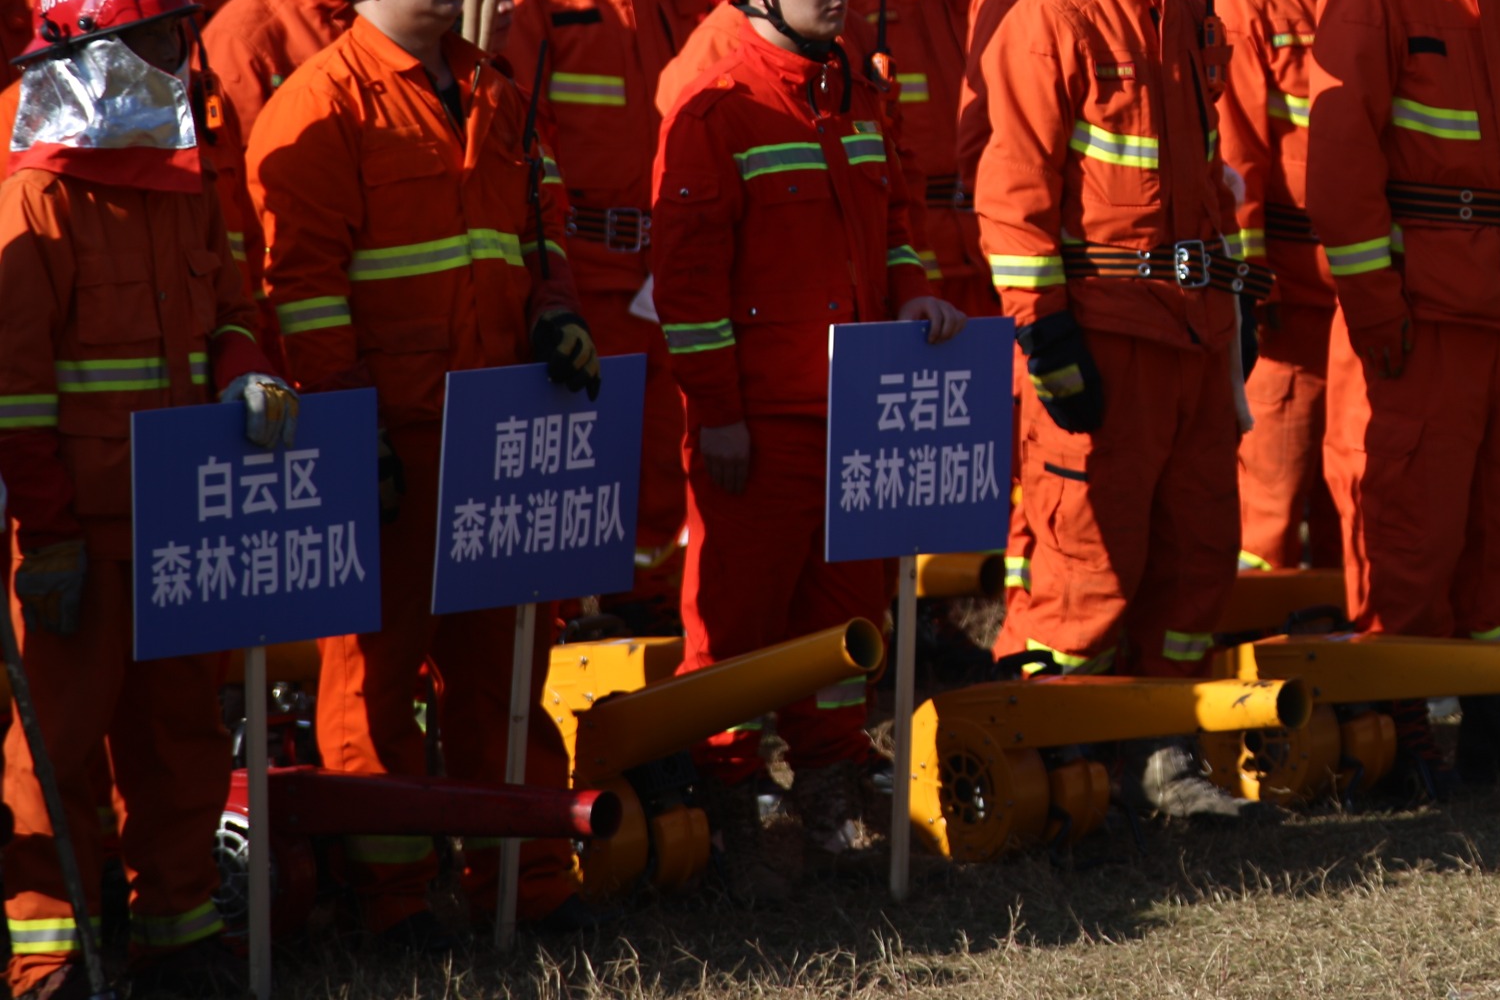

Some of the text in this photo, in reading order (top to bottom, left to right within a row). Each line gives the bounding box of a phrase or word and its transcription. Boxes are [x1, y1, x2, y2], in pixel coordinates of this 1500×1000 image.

[877, 369, 971, 432] 云岩区
[493, 411, 597, 480] 南明区
[840, 441, 999, 512] 森林消防队
[197, 448, 321, 522] 白云区
[450, 482, 625, 563] 森林消防队
[151, 521, 365, 608] 森林消防队
